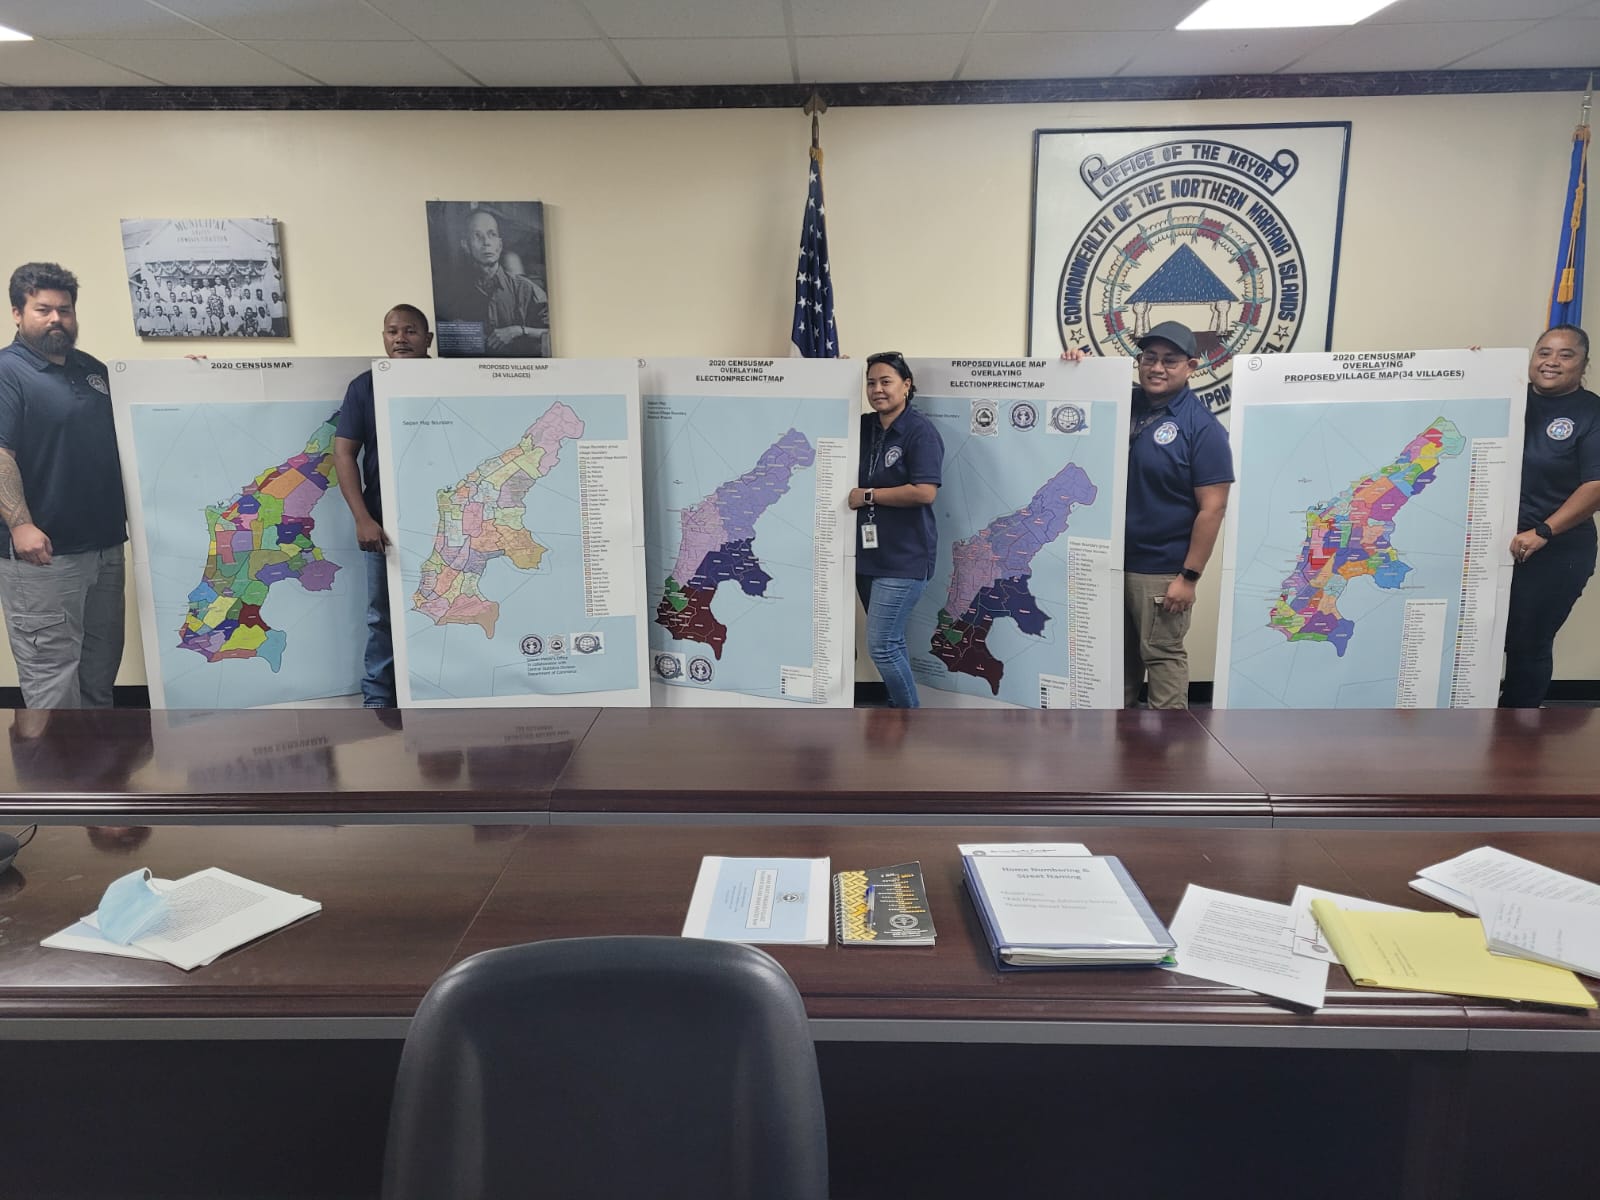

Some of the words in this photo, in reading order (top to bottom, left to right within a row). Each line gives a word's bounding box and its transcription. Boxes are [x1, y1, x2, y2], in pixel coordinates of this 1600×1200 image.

[1102, 151, 1155, 188] OFFICE
[1162, 144, 1183, 162] OF
[1191, 143, 1220, 161] THE
[1227, 149, 1275, 184] MAYOR
[1064, 219, 1113, 326] COMMONWEALTH
[1112, 201, 1134, 223] OF
[1133, 180, 1166, 209] THE
[1170, 177, 1249, 213] NORTHERN
[1246, 203, 1293, 259] MARIANA
[1277, 259, 1300, 323] ISLANDS
[1332, 353, 1356, 362] 2020
[708, 359, 727, 367] 2020
[1028, 360, 1047, 369] MAP
[1342, 360, 1404, 370] OVERLAYING
[971, 369, 1023, 377] OVERLAYING
[1416, 369, 1465, 379] VILLAGES)
[1199, 383, 1233, 409] IPAN
